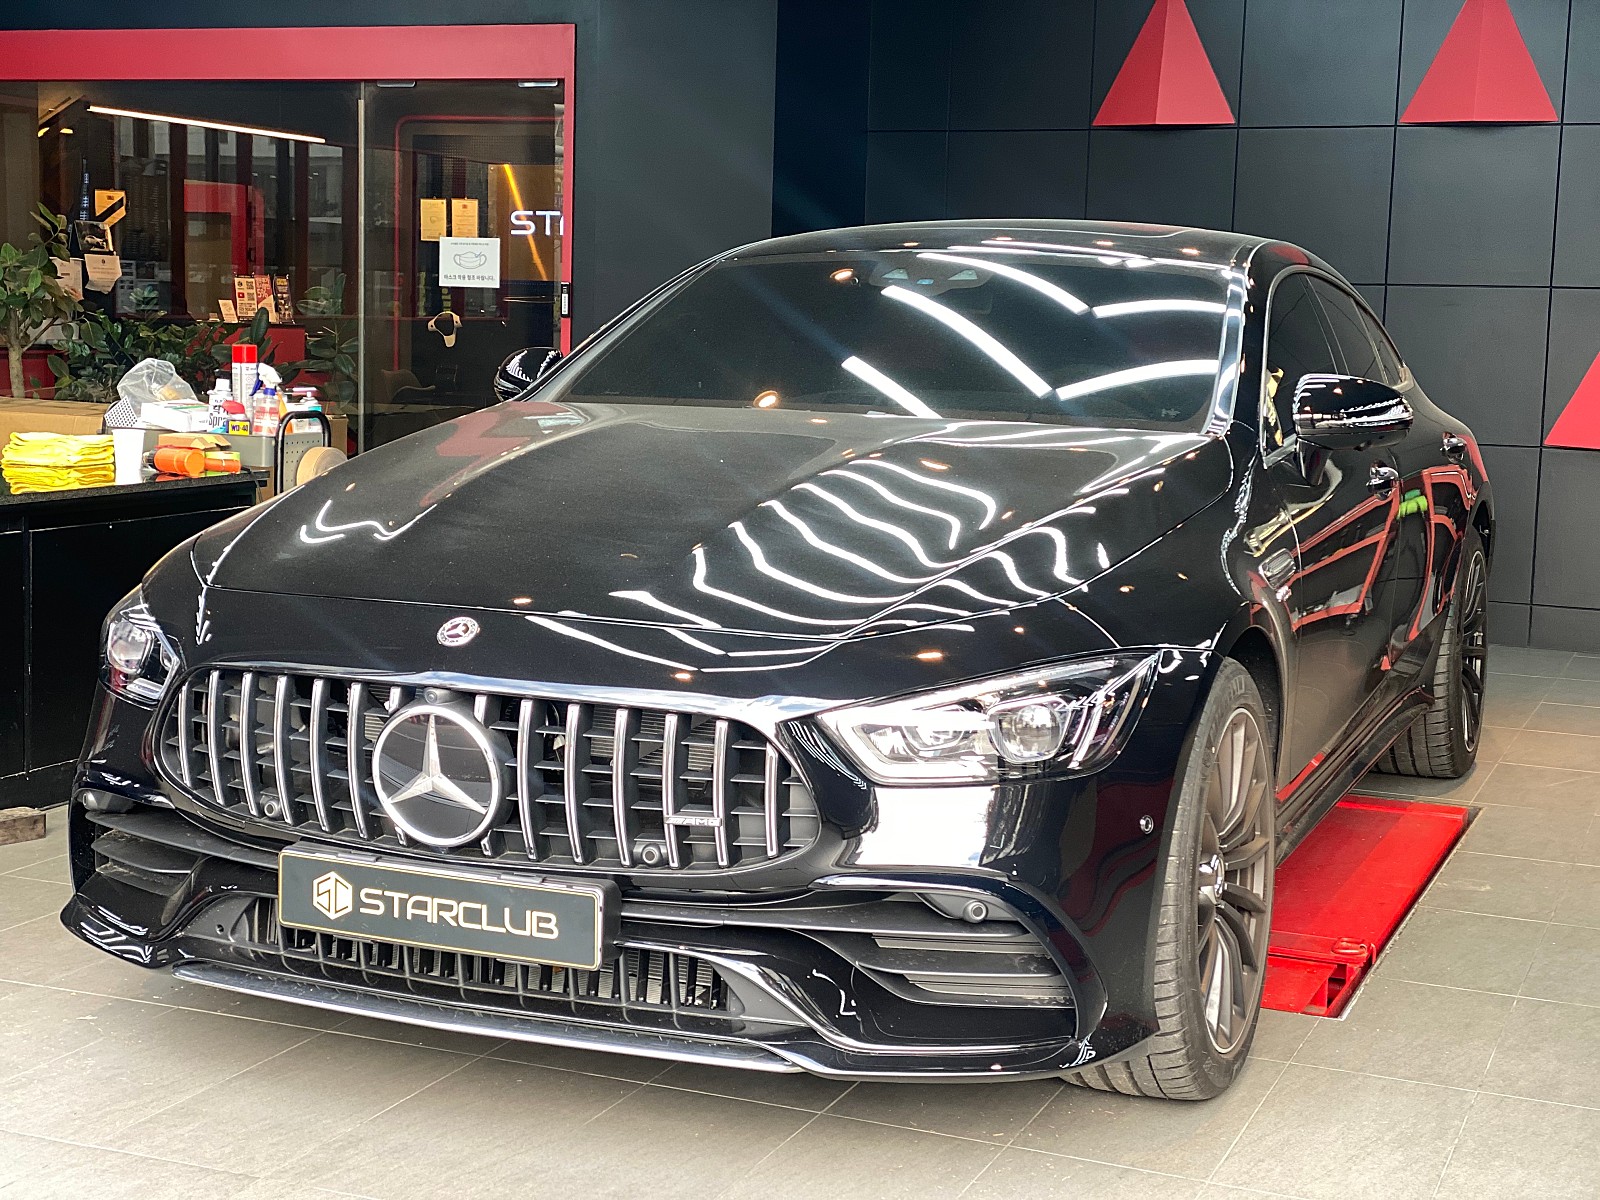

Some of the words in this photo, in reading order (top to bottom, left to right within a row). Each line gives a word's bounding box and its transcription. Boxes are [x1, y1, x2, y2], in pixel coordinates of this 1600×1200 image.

[208, 412, 227, 428] Spra
[231, 423, 249, 432] WD-40
[359, 888, 559, 940] STARCLUB
